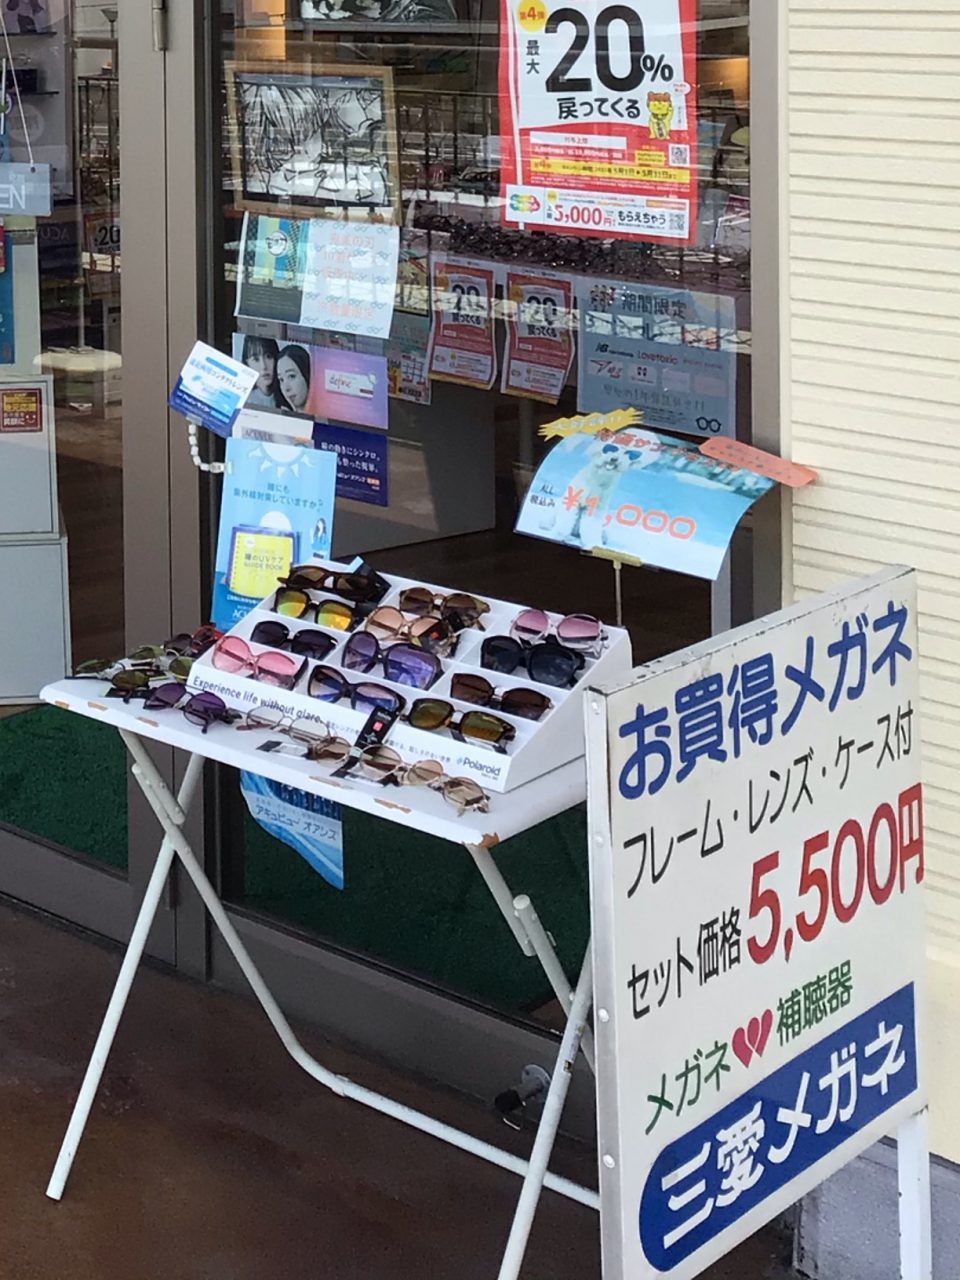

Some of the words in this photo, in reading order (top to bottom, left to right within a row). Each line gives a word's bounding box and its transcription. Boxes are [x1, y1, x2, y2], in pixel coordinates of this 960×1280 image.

[525, 39, 540, 75] 最大
[557, 96, 641, 121] 戻ってくる
[540, 483, 555, 495] ALL
[192, 675, 242, 701] Experience
[243, 690, 259, 706] life
[260, 696, 295, 718] without
[618, 600, 912, 801] お買得メガネ
[462, 756, 502, 777] Polaroid
[623, 707, 913, 899] フレーム・レンズ・ケース付
[627, 906, 742, 1021] セット価格
[746, 782, 924, 967] 5,500円
[645, 1039, 732, 1136] メガネ
[776, 959, 853, 1046] 補聴器
[662, 1022, 908, 1250] 三愛メガネ
